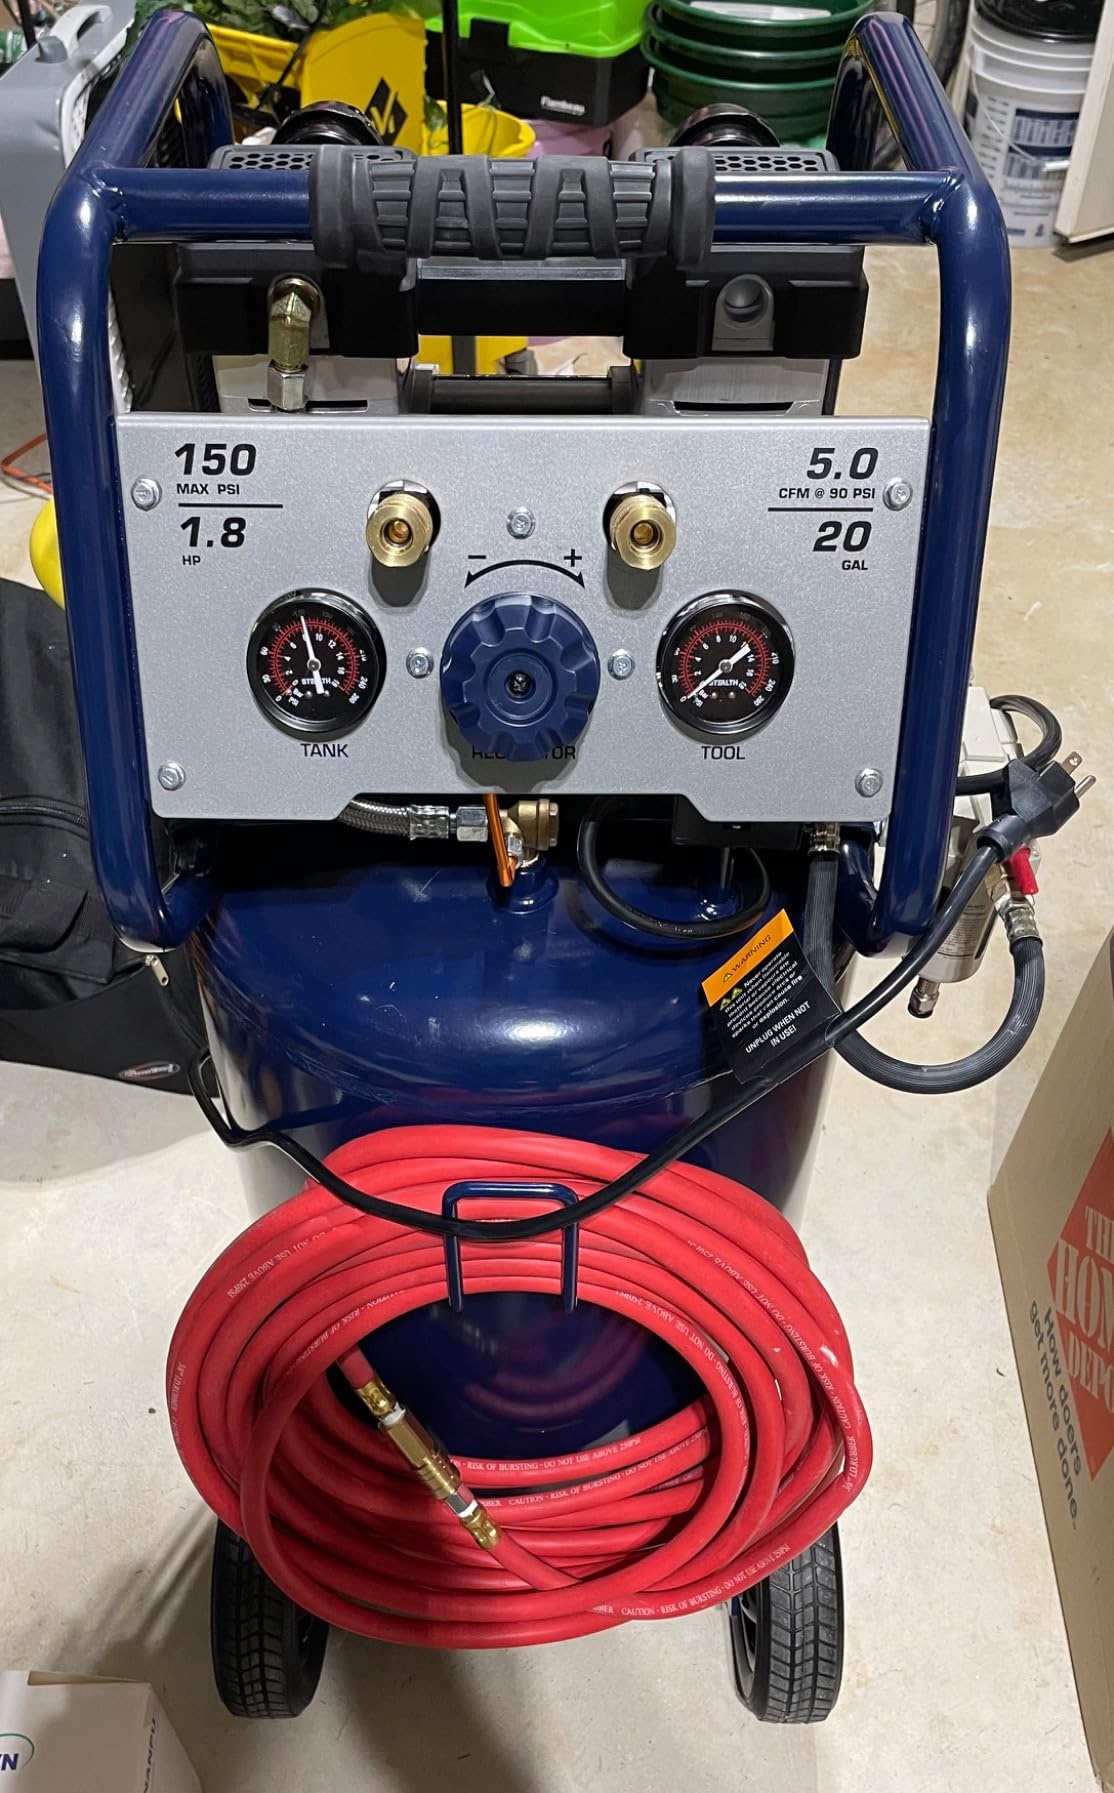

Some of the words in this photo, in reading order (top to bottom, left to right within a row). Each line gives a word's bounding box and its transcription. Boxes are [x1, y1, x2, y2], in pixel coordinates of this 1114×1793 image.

[175, 444, 256, 476] 150
[807, 448, 878, 480] 5.0
[176, 483, 208, 495] MAX
[218, 484, 240, 495] PSI
[778, 488, 810, 499] CFM
[814, 488, 825, 499] @
[828, 488, 849, 499] 90
[853, 488, 875, 499] PSI
[180, 516, 246, 548] 1.8
[813, 520, 871, 552] 20
[182, 555, 201, 566] HP
[842, 560, 868, 570] GAL
[316, 633, 323, 641] 10
[328, 640, 336, 649] 12
[730, 635, 737, 643] 10
[336, 652, 344, 660] 14
[746, 654, 755, 662] 14
[301, 677, 331, 685] STETH
[358, 676, 368, 689] 240
[766, 679, 776, 692] 240
[300, 744, 349, 758] TANK
[701, 746, 745, 760] TOOL
[732, 934, 772, 972] WARNING
[744, 972, 761, 988] Never
[771, 961, 798, 986] electrical
[750, 1010, 762, 1021] that
[762, 1000, 774, 1010] can
[774, 985, 792, 1001] cause
[791, 975, 803, 986] fire
[759, 998, 789, 1023] explosion.
[731, 1011, 753, 1030] devices
[745, 1028, 773, 1054] UNPLUG
[772, 1013, 796, 1033] WHEN
[793, 1001, 811, 1016] NOT
[770, 1036, 780, 1047] IN
[779, 1025, 797, 1041] USE!
[1085, 1206, 1114, 1264] TH
[274, 1250, 291, 1262] USE
[248, 1258, 274, 1281] ABOVE
[227, 1277, 247, 1298] 250PSI
[743, 1280, 757, 1294] USE
[756, 1294, 774, 1308] NOT
[342, 1308, 360, 1324] RISK
[645, 1300, 674, 1322] ABOVE
[773, 1308, 784, 1321] DO
[330, 1322, 340, 1335] OF
[674, 1320, 689, 1339] USE
[689, 1333, 705, 1352] NOT
[786, 1322, 816, 1365] BURSTING
[704, 1347, 715, 1361] DO
[811, 1360, 822, 1372] OF
[1030, 1300, 1044, 1350] get
[1040, 1352, 1060, 1432] more
[716, 1360, 738, 1398] BURSTING
[821, 1371, 834, 1390] RISK
[1044, 1306, 1062, 1376] How
[1059, 1384, 1082, 1476] doers
[833, 1396, 851, 1428] CAUTION
[467, 1462, 484, 1471] RISK
[486, 1463, 497, 1471] OF
[499, 1463, 538, 1471] BURSTING
[558, 1457, 574, 1466] NOT
[576, 1455, 590, 1464] USE
[592, 1446, 619, 1460] ABOVE
[620, 1437, 641, 1451] 250PSI
[509, 1496, 544, 1506] CAUTION
[550, 1491, 569, 1501] RISK
[570, 1487, 580, 1496] OF
[582, 1473, 621, 1493] BURSTING
[625, 1467, 638, 1478] DO
[638, 1461, 652, 1473] NOT
[654, 1454, 667, 1464] USE
[621, 1606, 656, 1616] CAUTION
[660, 1602, 678, 1614] RISK
[678, 1599, 689, 1611] OF
[689, 1586, 722, 1608] BURSTING
[724, 1580, 734, 1590] DO
[734, 1571, 746, 1585] NOT
[746, 1565, 757, 1576] USE
[756, 1555, 775, 1571] ABOVE
[774, 1544, 790, 1558] 250PSI
